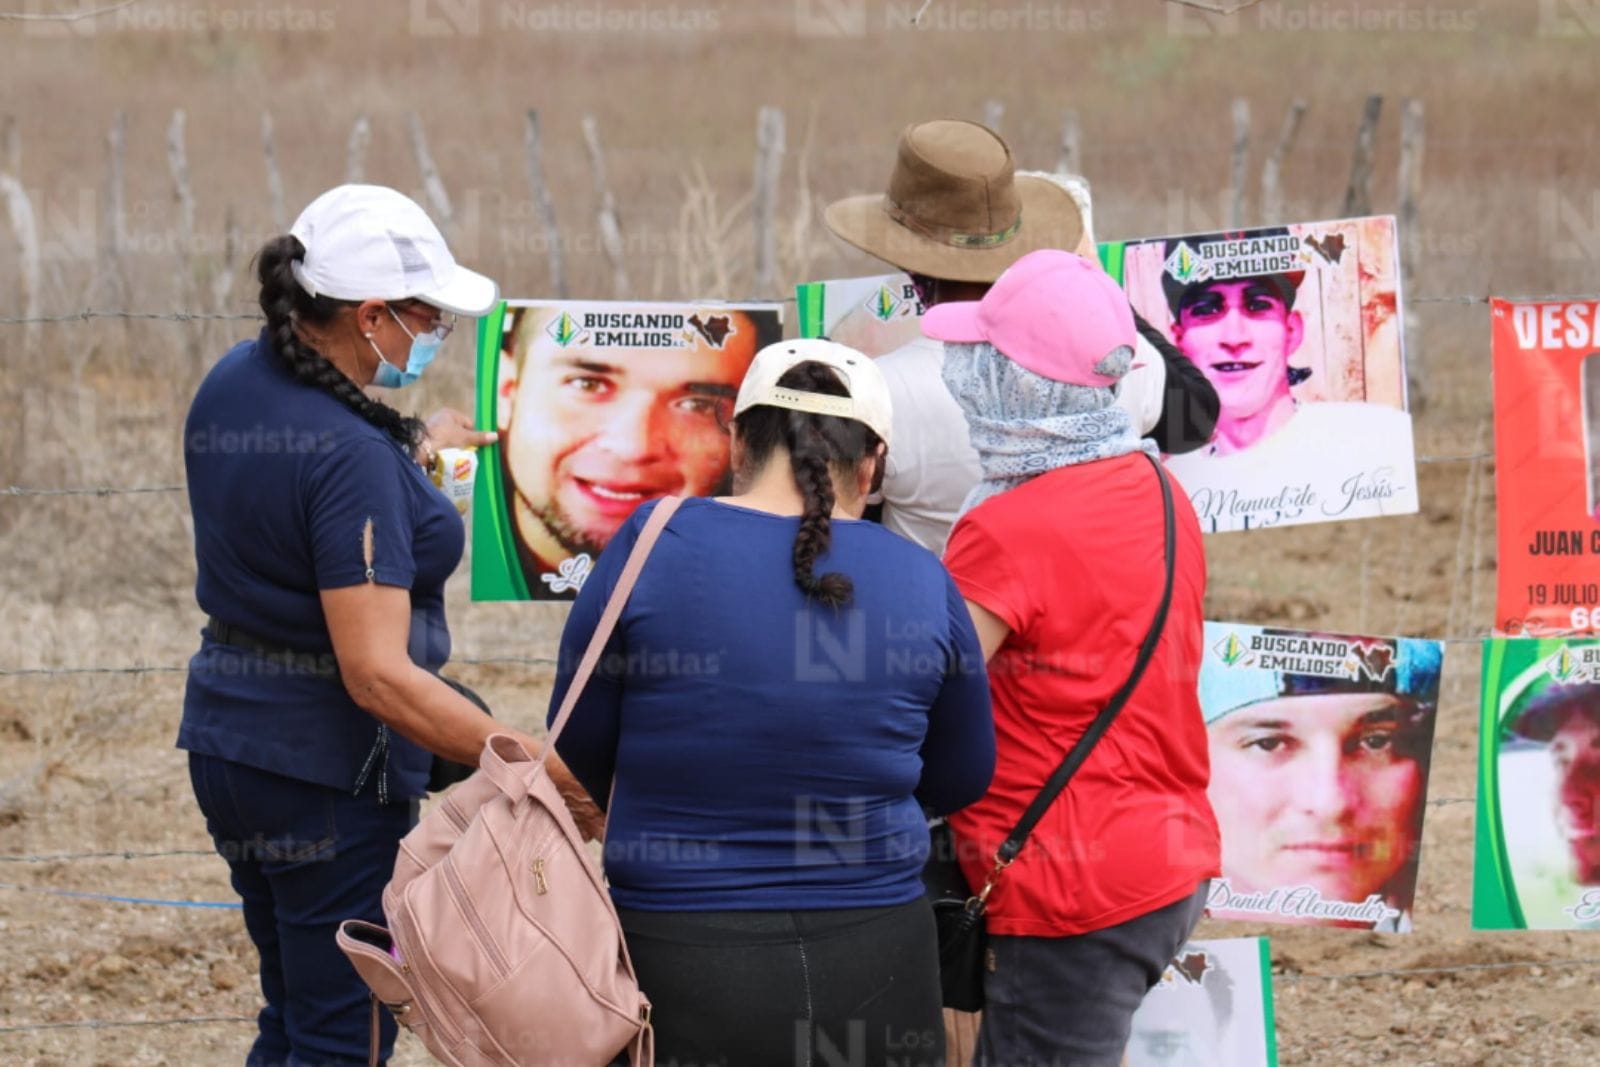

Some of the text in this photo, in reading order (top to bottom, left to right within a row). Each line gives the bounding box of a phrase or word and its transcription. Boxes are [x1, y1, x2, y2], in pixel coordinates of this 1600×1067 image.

[1203, 237, 1300, 260] BUSCANDO
[1215, 256, 1291, 277] EMILIOS
[584, 313, 684, 329] BUSCANDO
[594, 331, 672, 347] EMILIOS
[1193, 484, 1288, 518] Manuel
[1528, 531, 1583, 556] JUAN
[1528, 584, 1598, 605] 19 JULIO
[1250, 635, 1348, 658] BUSCANDO
[1259, 655, 1336, 675] EMILIOS
[1207, 879, 1280, 910] Daniel
